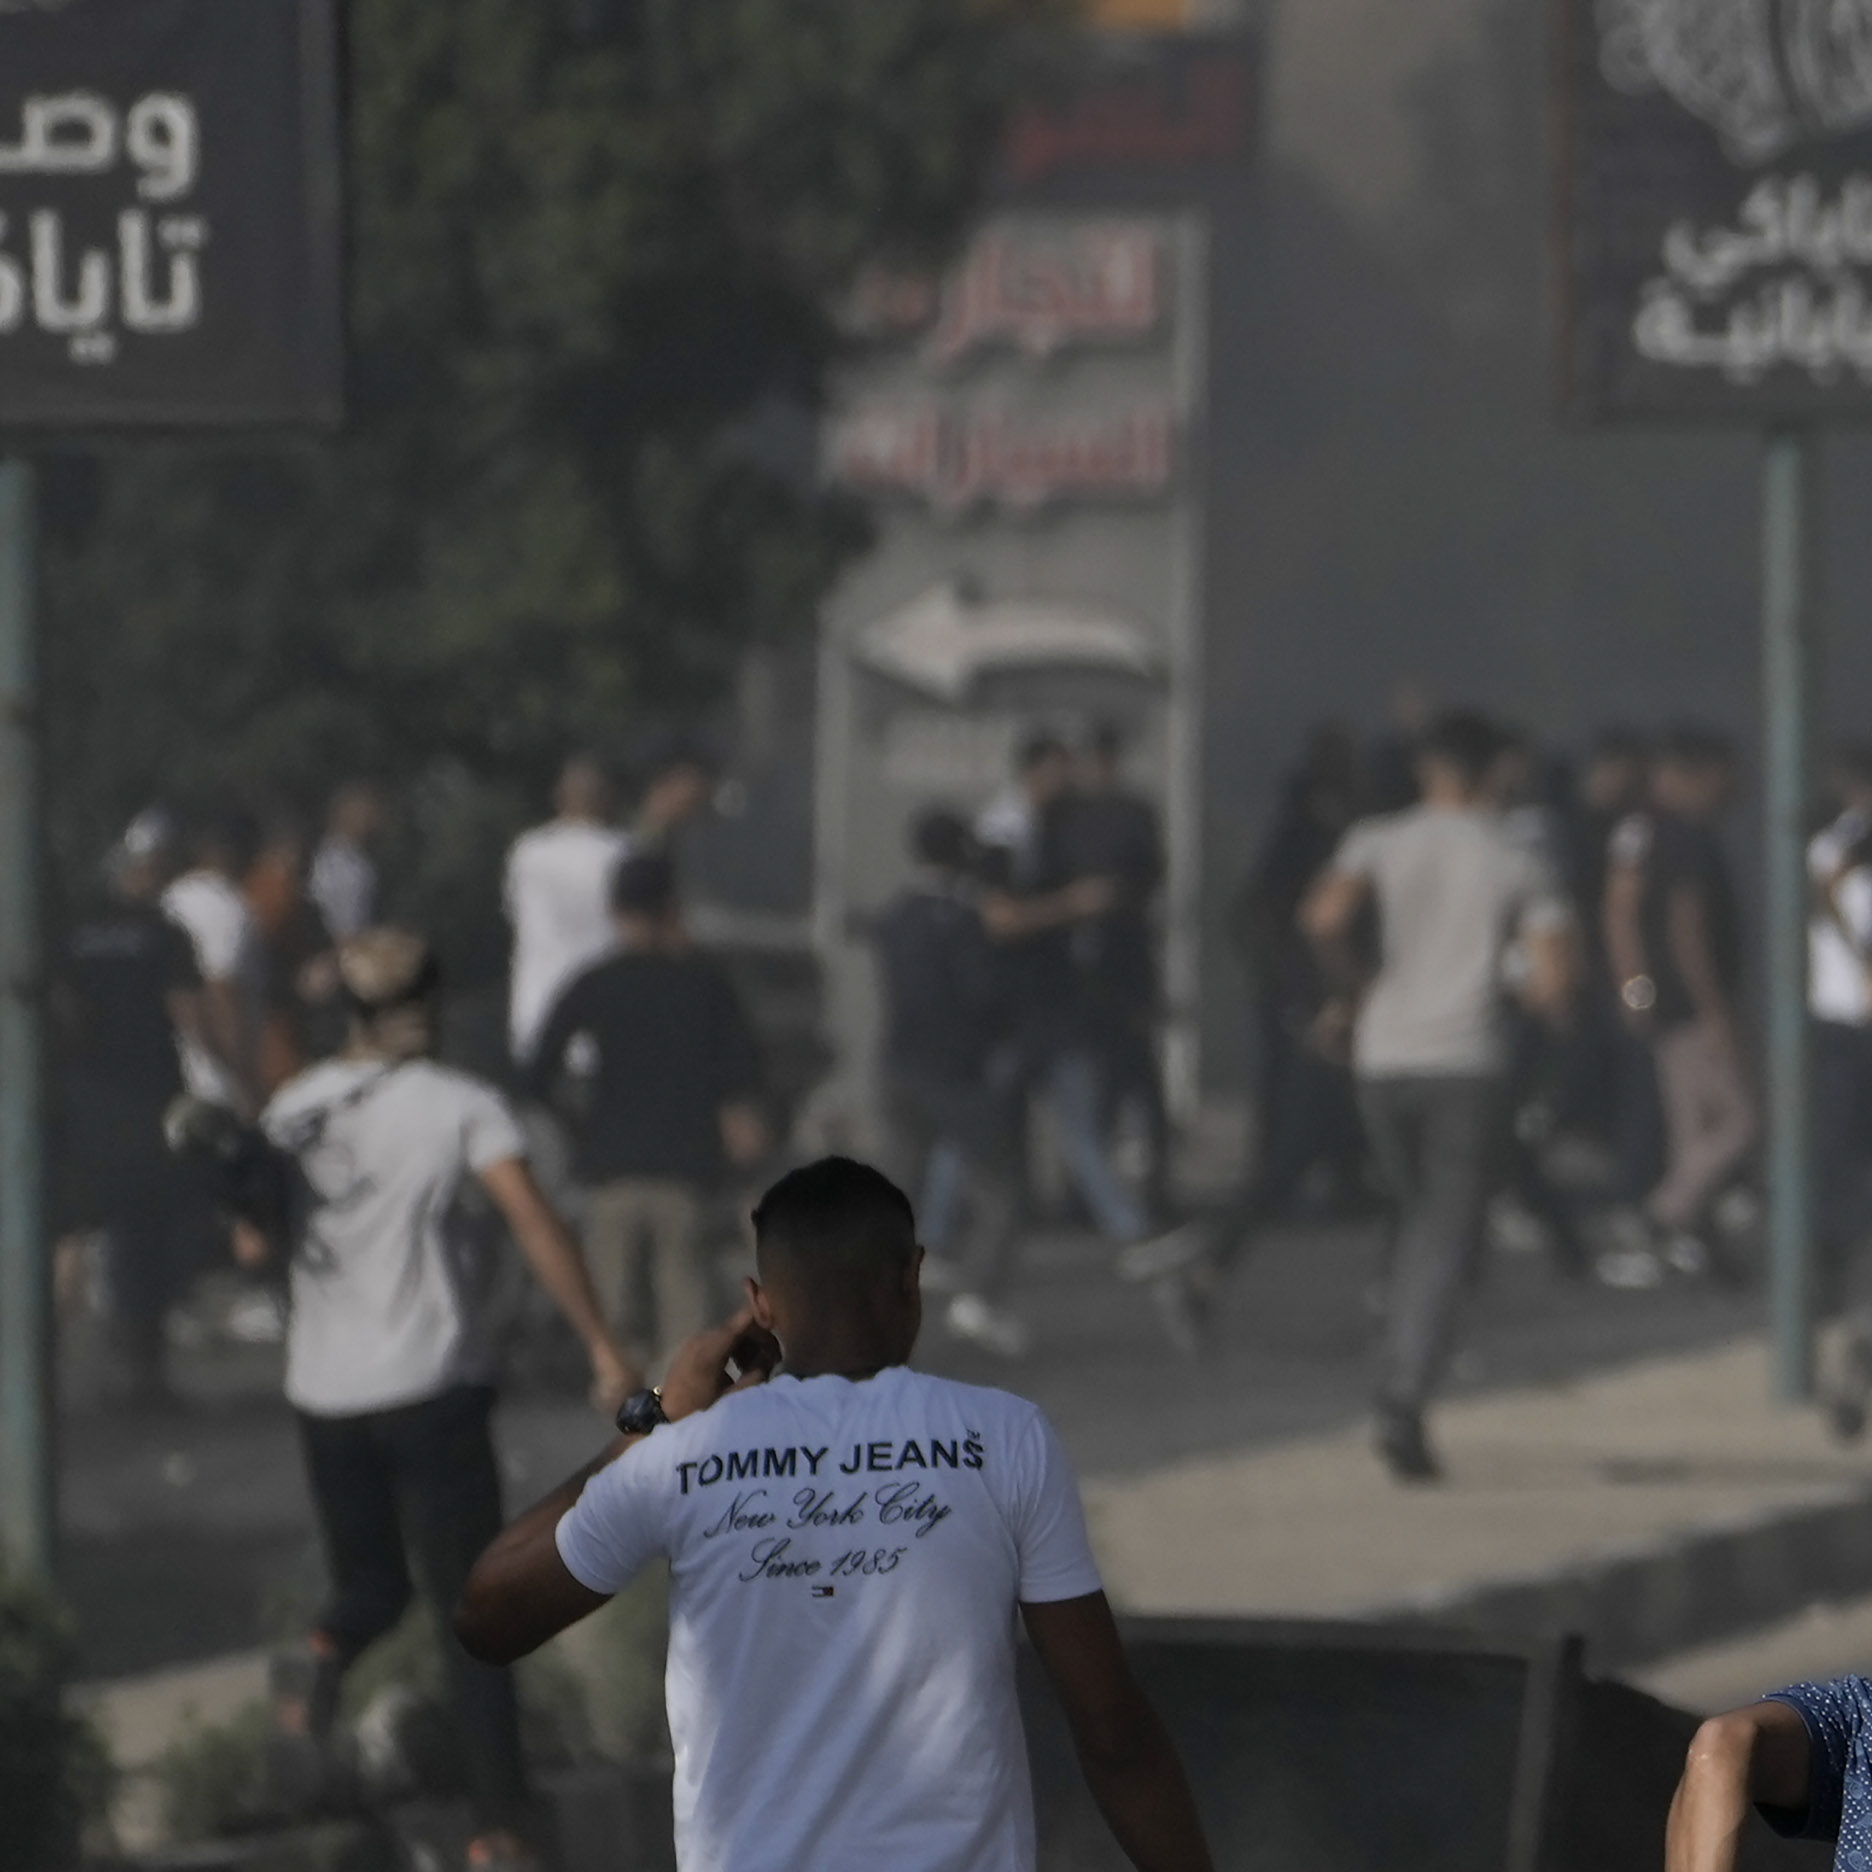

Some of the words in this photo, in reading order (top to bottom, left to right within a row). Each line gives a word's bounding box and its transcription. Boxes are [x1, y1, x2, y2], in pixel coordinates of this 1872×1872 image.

[0, 89, 200, 202] وص
[676, 1446, 828, 1494] TOMMY
[704, 1488, 775, 1538] New
[787, 1487, 865, 1530] York
[875, 1481, 953, 1538] City
[739, 1537, 822, 1582] Since
[830, 1546, 909, 1577] 1985
